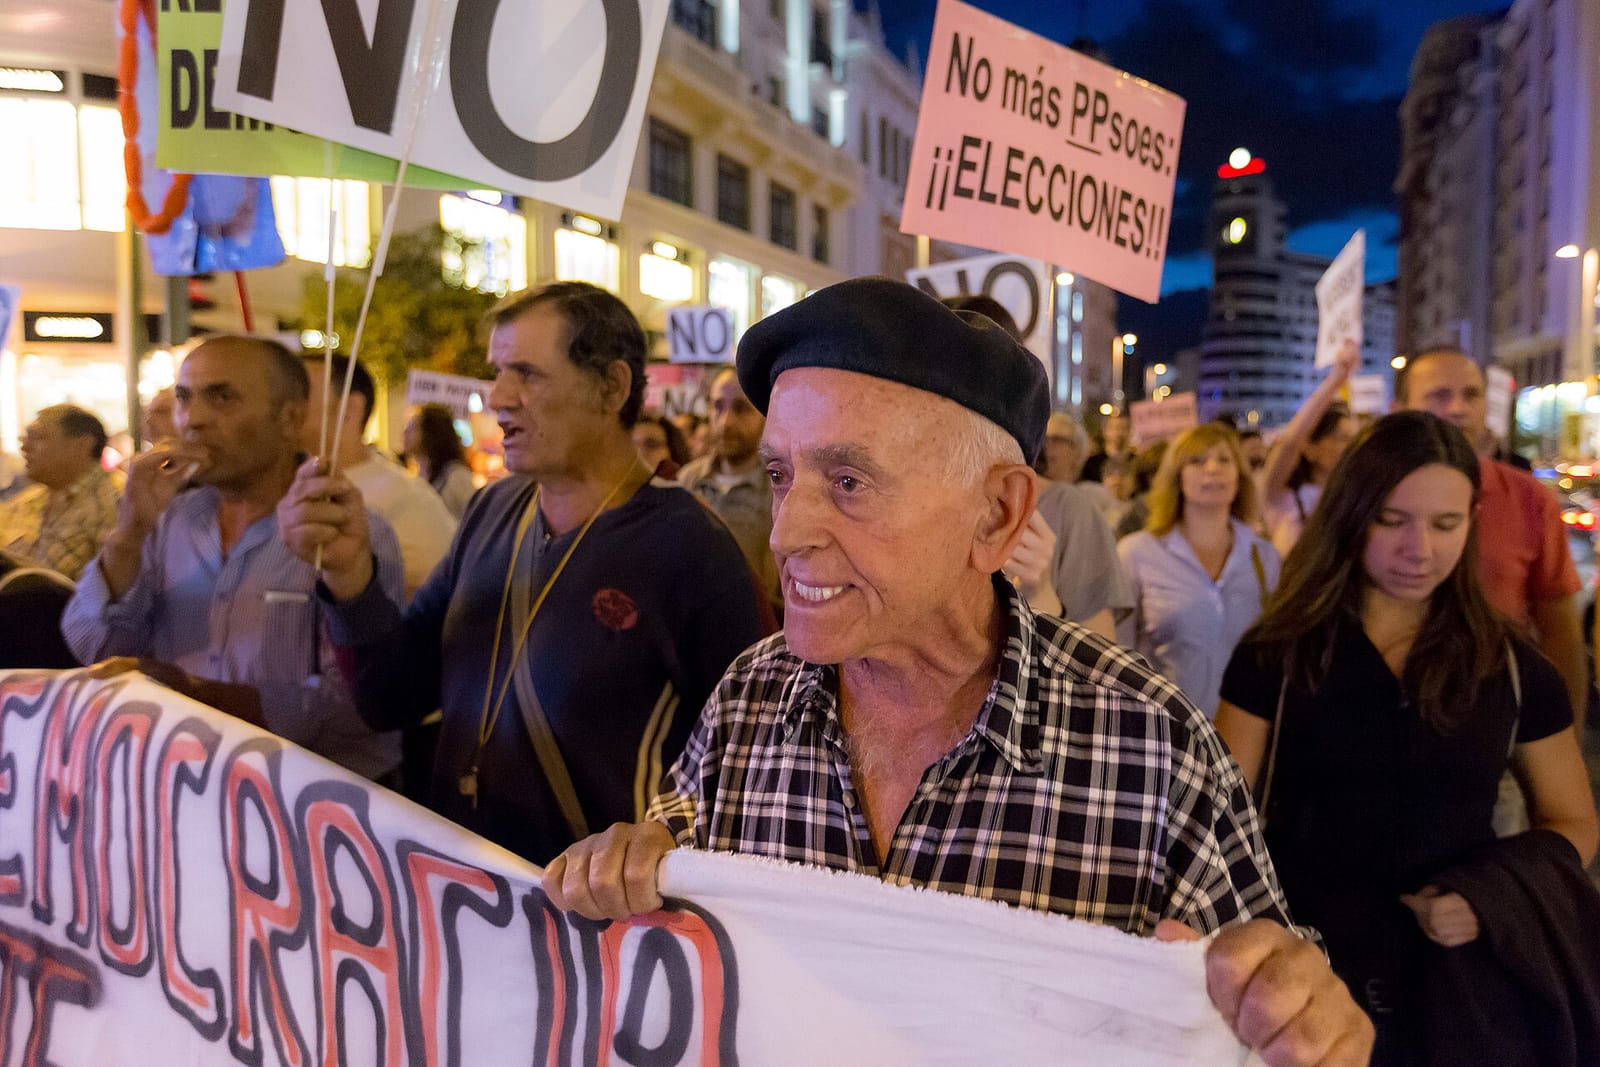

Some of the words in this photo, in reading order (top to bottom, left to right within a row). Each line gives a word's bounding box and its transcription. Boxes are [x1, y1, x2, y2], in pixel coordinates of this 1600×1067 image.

[237, 0, 641, 182] NO
[945, 32, 992, 102] No
[1002, 66, 1061, 129] más
[1067, 82, 1174, 176] PPsoes:
[926, 135, 1165, 260] ¡¡ELECCIONES!!
[671, 311, 728, 354] NO
